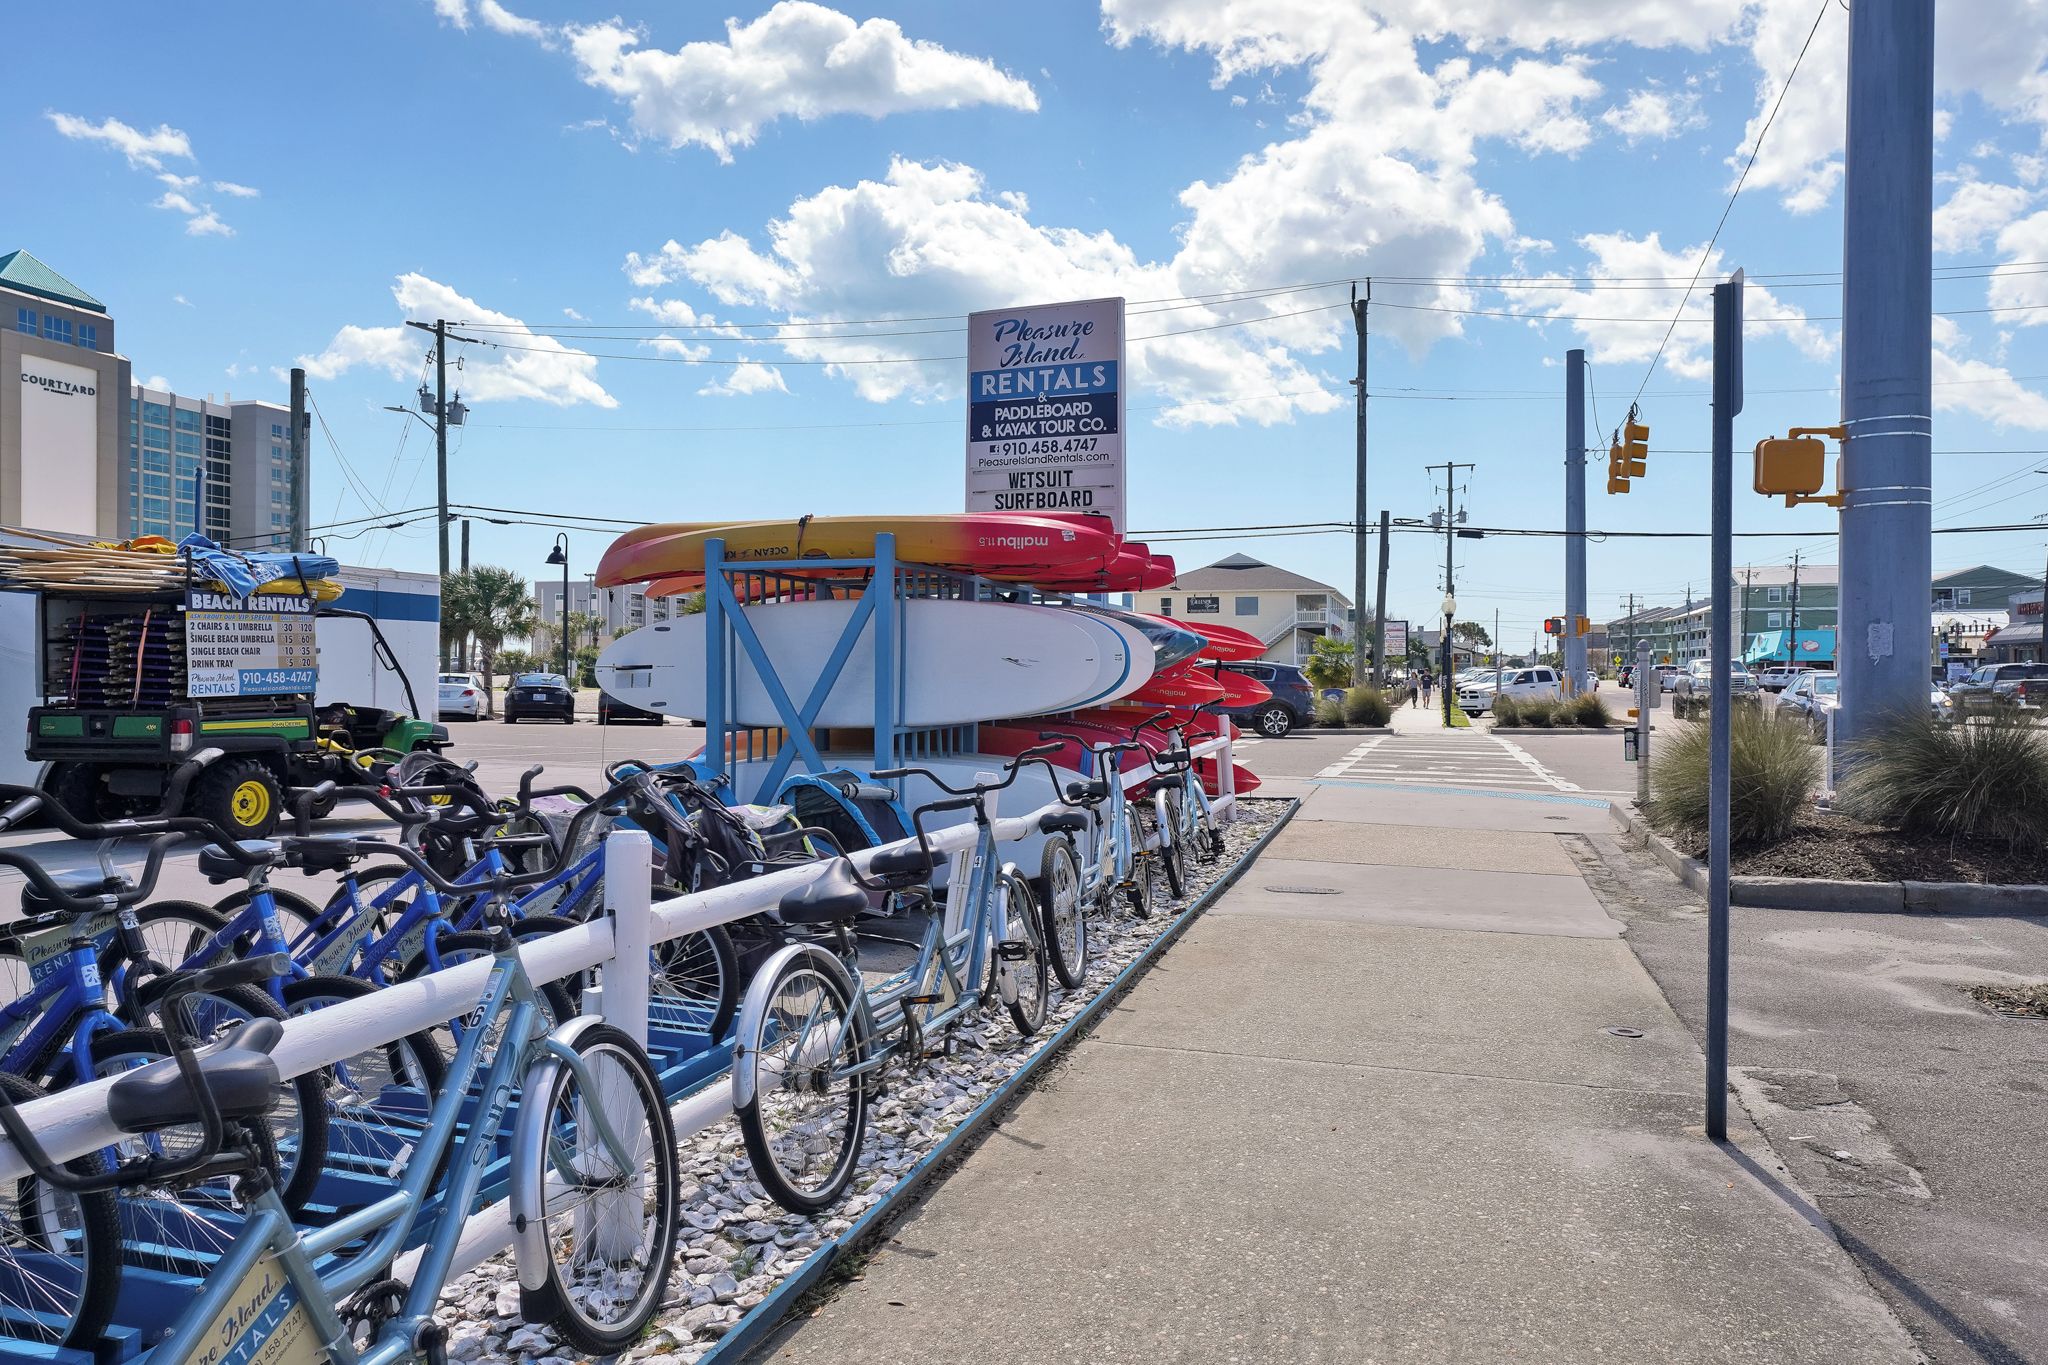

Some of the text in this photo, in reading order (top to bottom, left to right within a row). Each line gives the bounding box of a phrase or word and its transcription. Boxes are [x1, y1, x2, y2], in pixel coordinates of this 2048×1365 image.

[993, 318, 1094, 343] Pleasure
[1000, 337, 1082, 368] Island
[21, 373, 96, 396] COURTYARD
[982, 365, 1106, 396] RENTALS
[1038, 391, 1048, 402] &
[995, 402, 1092, 421] PADDLEBOARD
[982, 417, 1107, 438] & KAYAK TOUR CO.
[1003, 438, 1098, 455] 910.458.4747
[978, 451, 1109, 467] PleasureIslandRentals.com
[1008, 470, 1073, 489] WETSUIT
[994, 490, 1093, 510] SURFBOARD
[754, 546, 789, 557] OCEAN
[997, 536, 1049, 550] malibu
[192, 593, 310, 612] BEACH RENTALS
[190, 622, 195, 631] 2
[197, 622, 222, 631] CHAIRS
[224, 622, 230, 631] &
[238, 623, 273, 631] UMBRELLA
[190, 635, 275, 644] SINGLE BEACH UMBRELLA
[190, 647, 261, 656] SINGLE BEACH CHAIR
[191, 660, 234, 668] DRINK TRAY
[242, 671, 312, 685] 910-458-4747
[191, 683, 236, 695] RENTALS
[974, 856, 981, 867] 4
[318, 913, 371, 972] Pleasure Island
[469, 1006, 485, 1029] 6
[222, 1273, 276, 1348] Island
[264, 1309, 302, 1361] 458-4747
